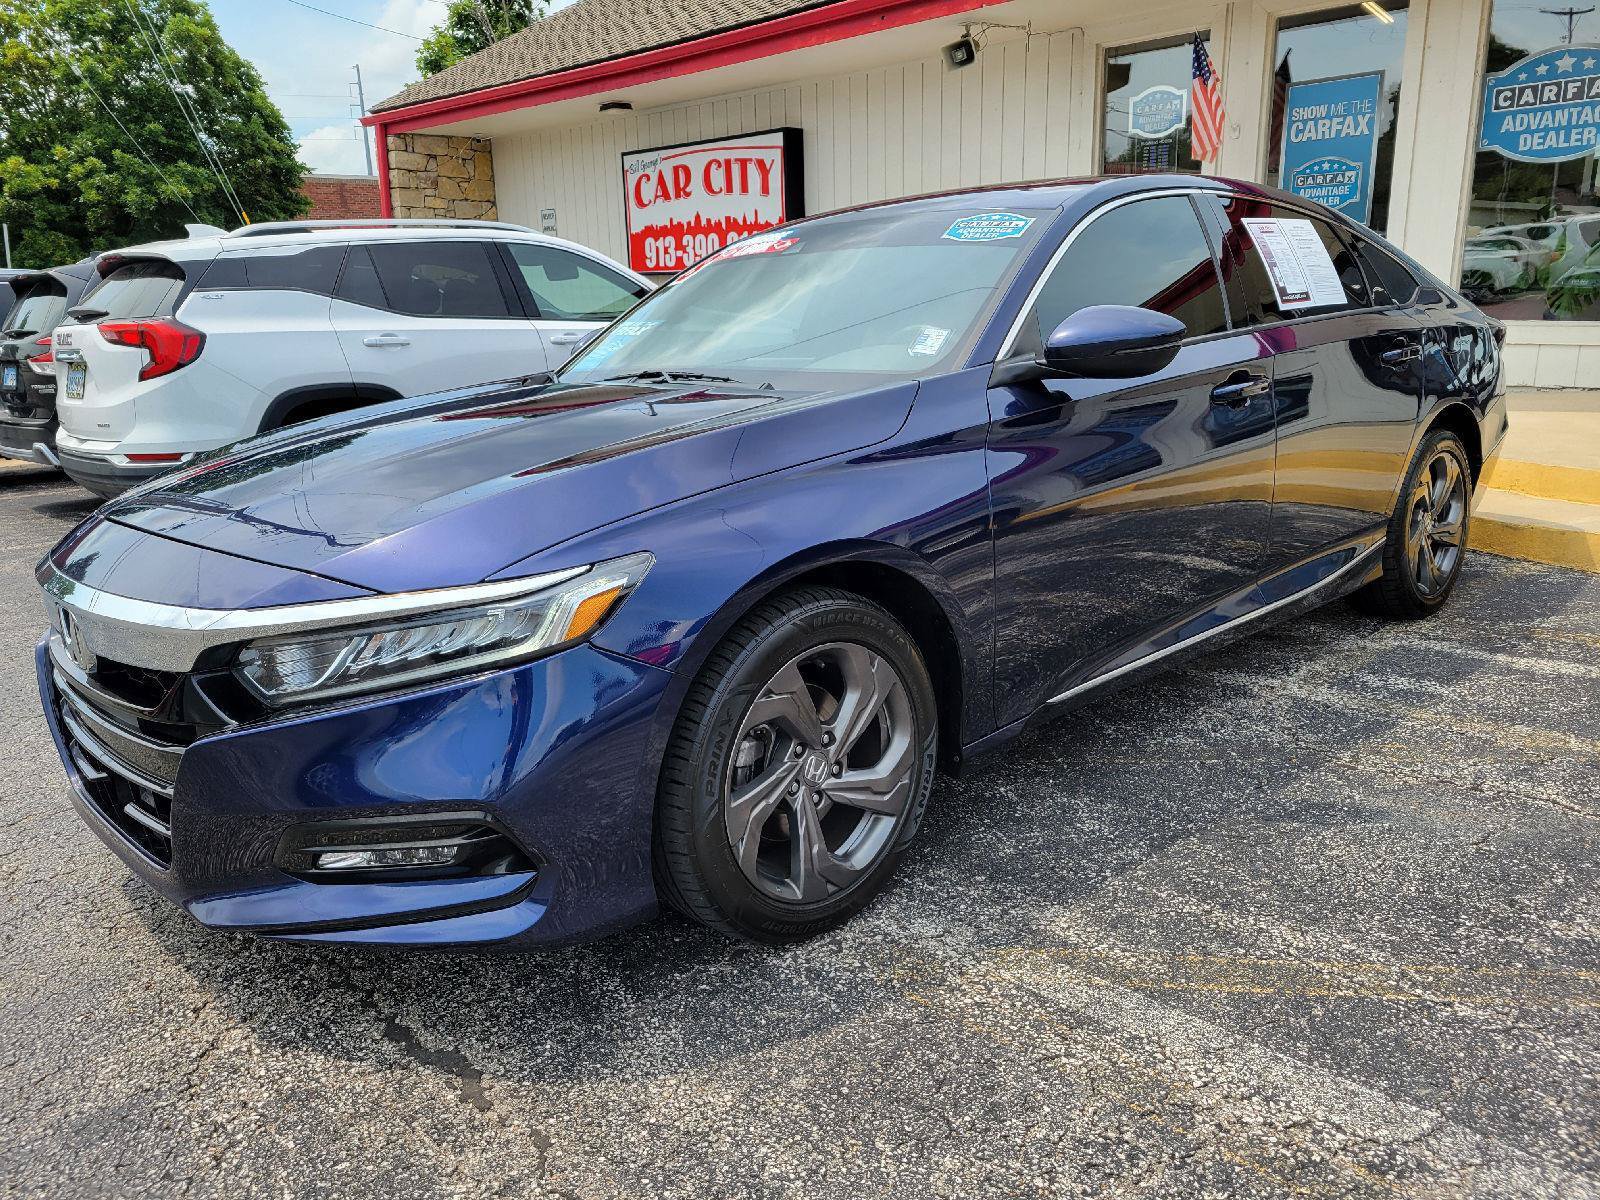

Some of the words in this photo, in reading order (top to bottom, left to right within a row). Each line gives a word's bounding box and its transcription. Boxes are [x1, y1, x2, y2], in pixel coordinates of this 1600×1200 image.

[1137, 102, 1180, 114] CARFAX
[1292, 104, 1328, 120] SHOW
[1331, 102, 1348, 116] ME
[1352, 99, 1373, 113] THE
[1290, 113, 1370, 143] CARFAX
[1519, 126, 1597, 151] DEALER
[634, 164, 693, 209] CAR
[702, 158, 775, 197] CITY
[1296, 171, 1356, 186] CARFAX
[1300, 185, 1350, 197] ADVANTAGE
[1312, 196, 1340, 206] EALER
